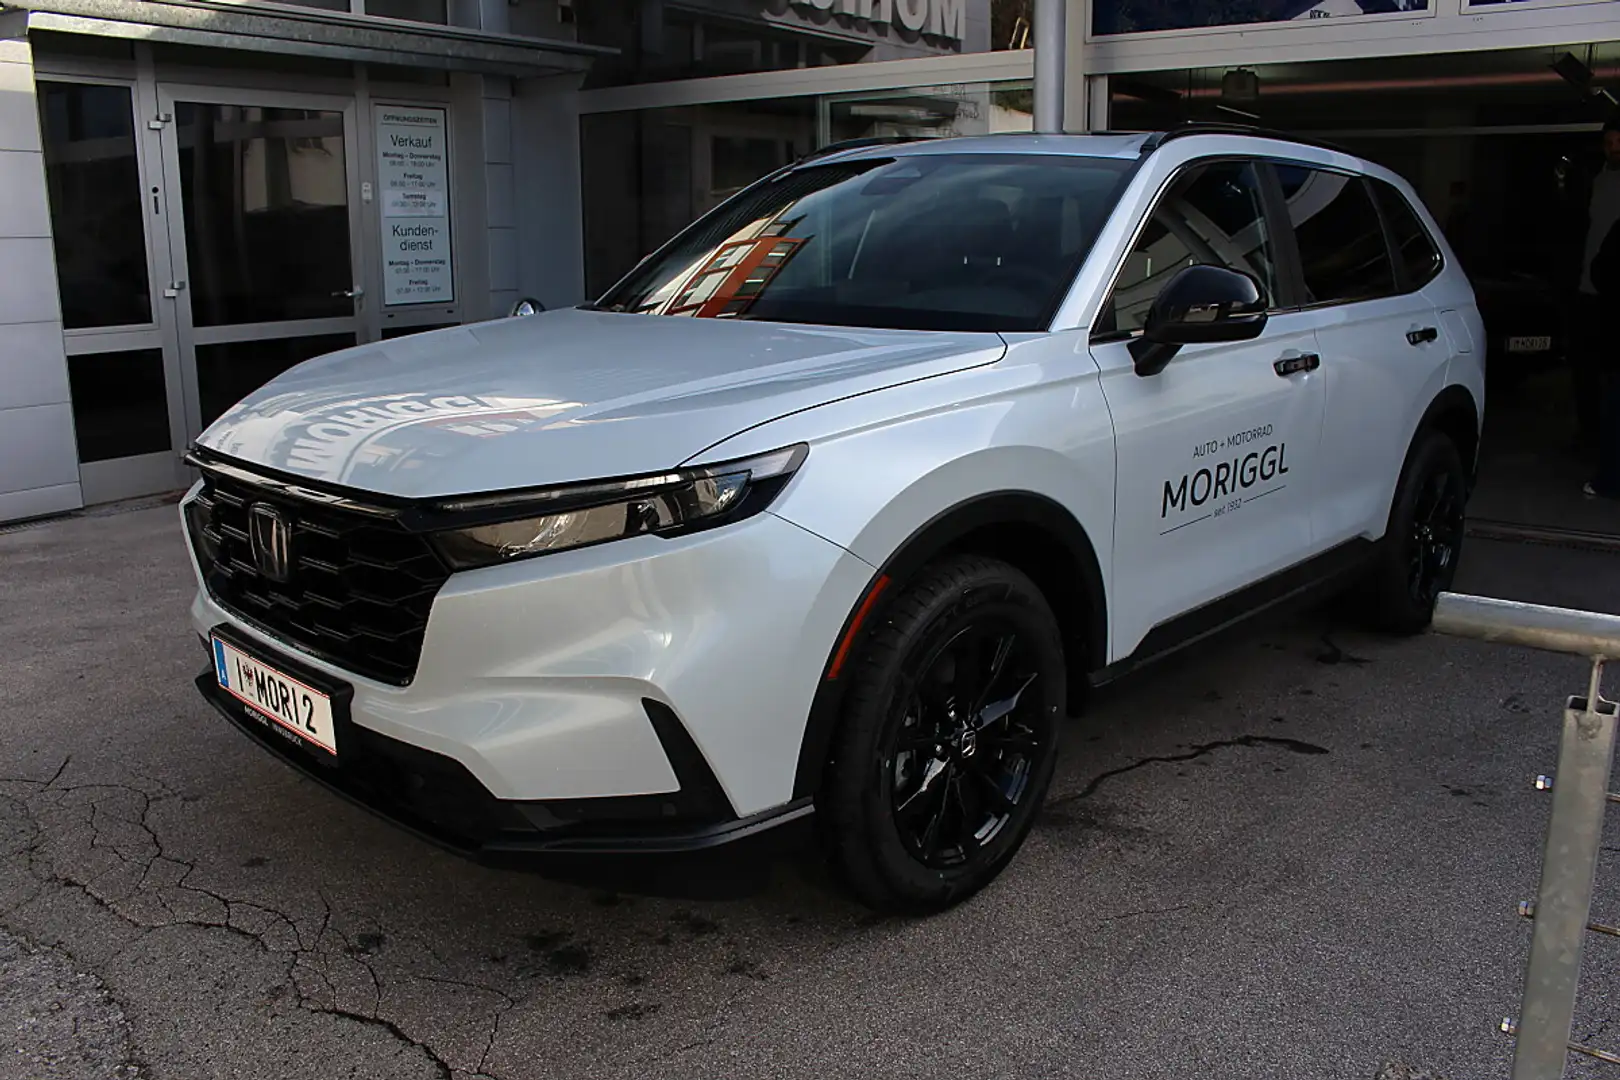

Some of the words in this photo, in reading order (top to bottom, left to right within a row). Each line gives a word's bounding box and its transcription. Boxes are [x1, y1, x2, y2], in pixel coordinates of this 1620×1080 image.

[390, 134, 433, 149] Verkauf
[382, 151, 404, 160] Montag
[409, 152, 441, 161] Donnerstag
[403, 172, 423, 181] Freitag
[392, 225, 439, 237] Kunden-
[400, 239, 433, 251] dienst
[388, 259, 409, 268] Montag
[414, 258, 446, 266] Donnerstag
[408, 278, 428, 287] Freitag
[1193, 440, 1218, 459] AUTO
[1227, 424, 1273, 449] MOTORRAD
[1161, 443, 1289, 518] MORIGGL
[236, 657, 244, 692] I
[254, 667, 300, 724] MORI
[302, 694, 317, 735] 2
